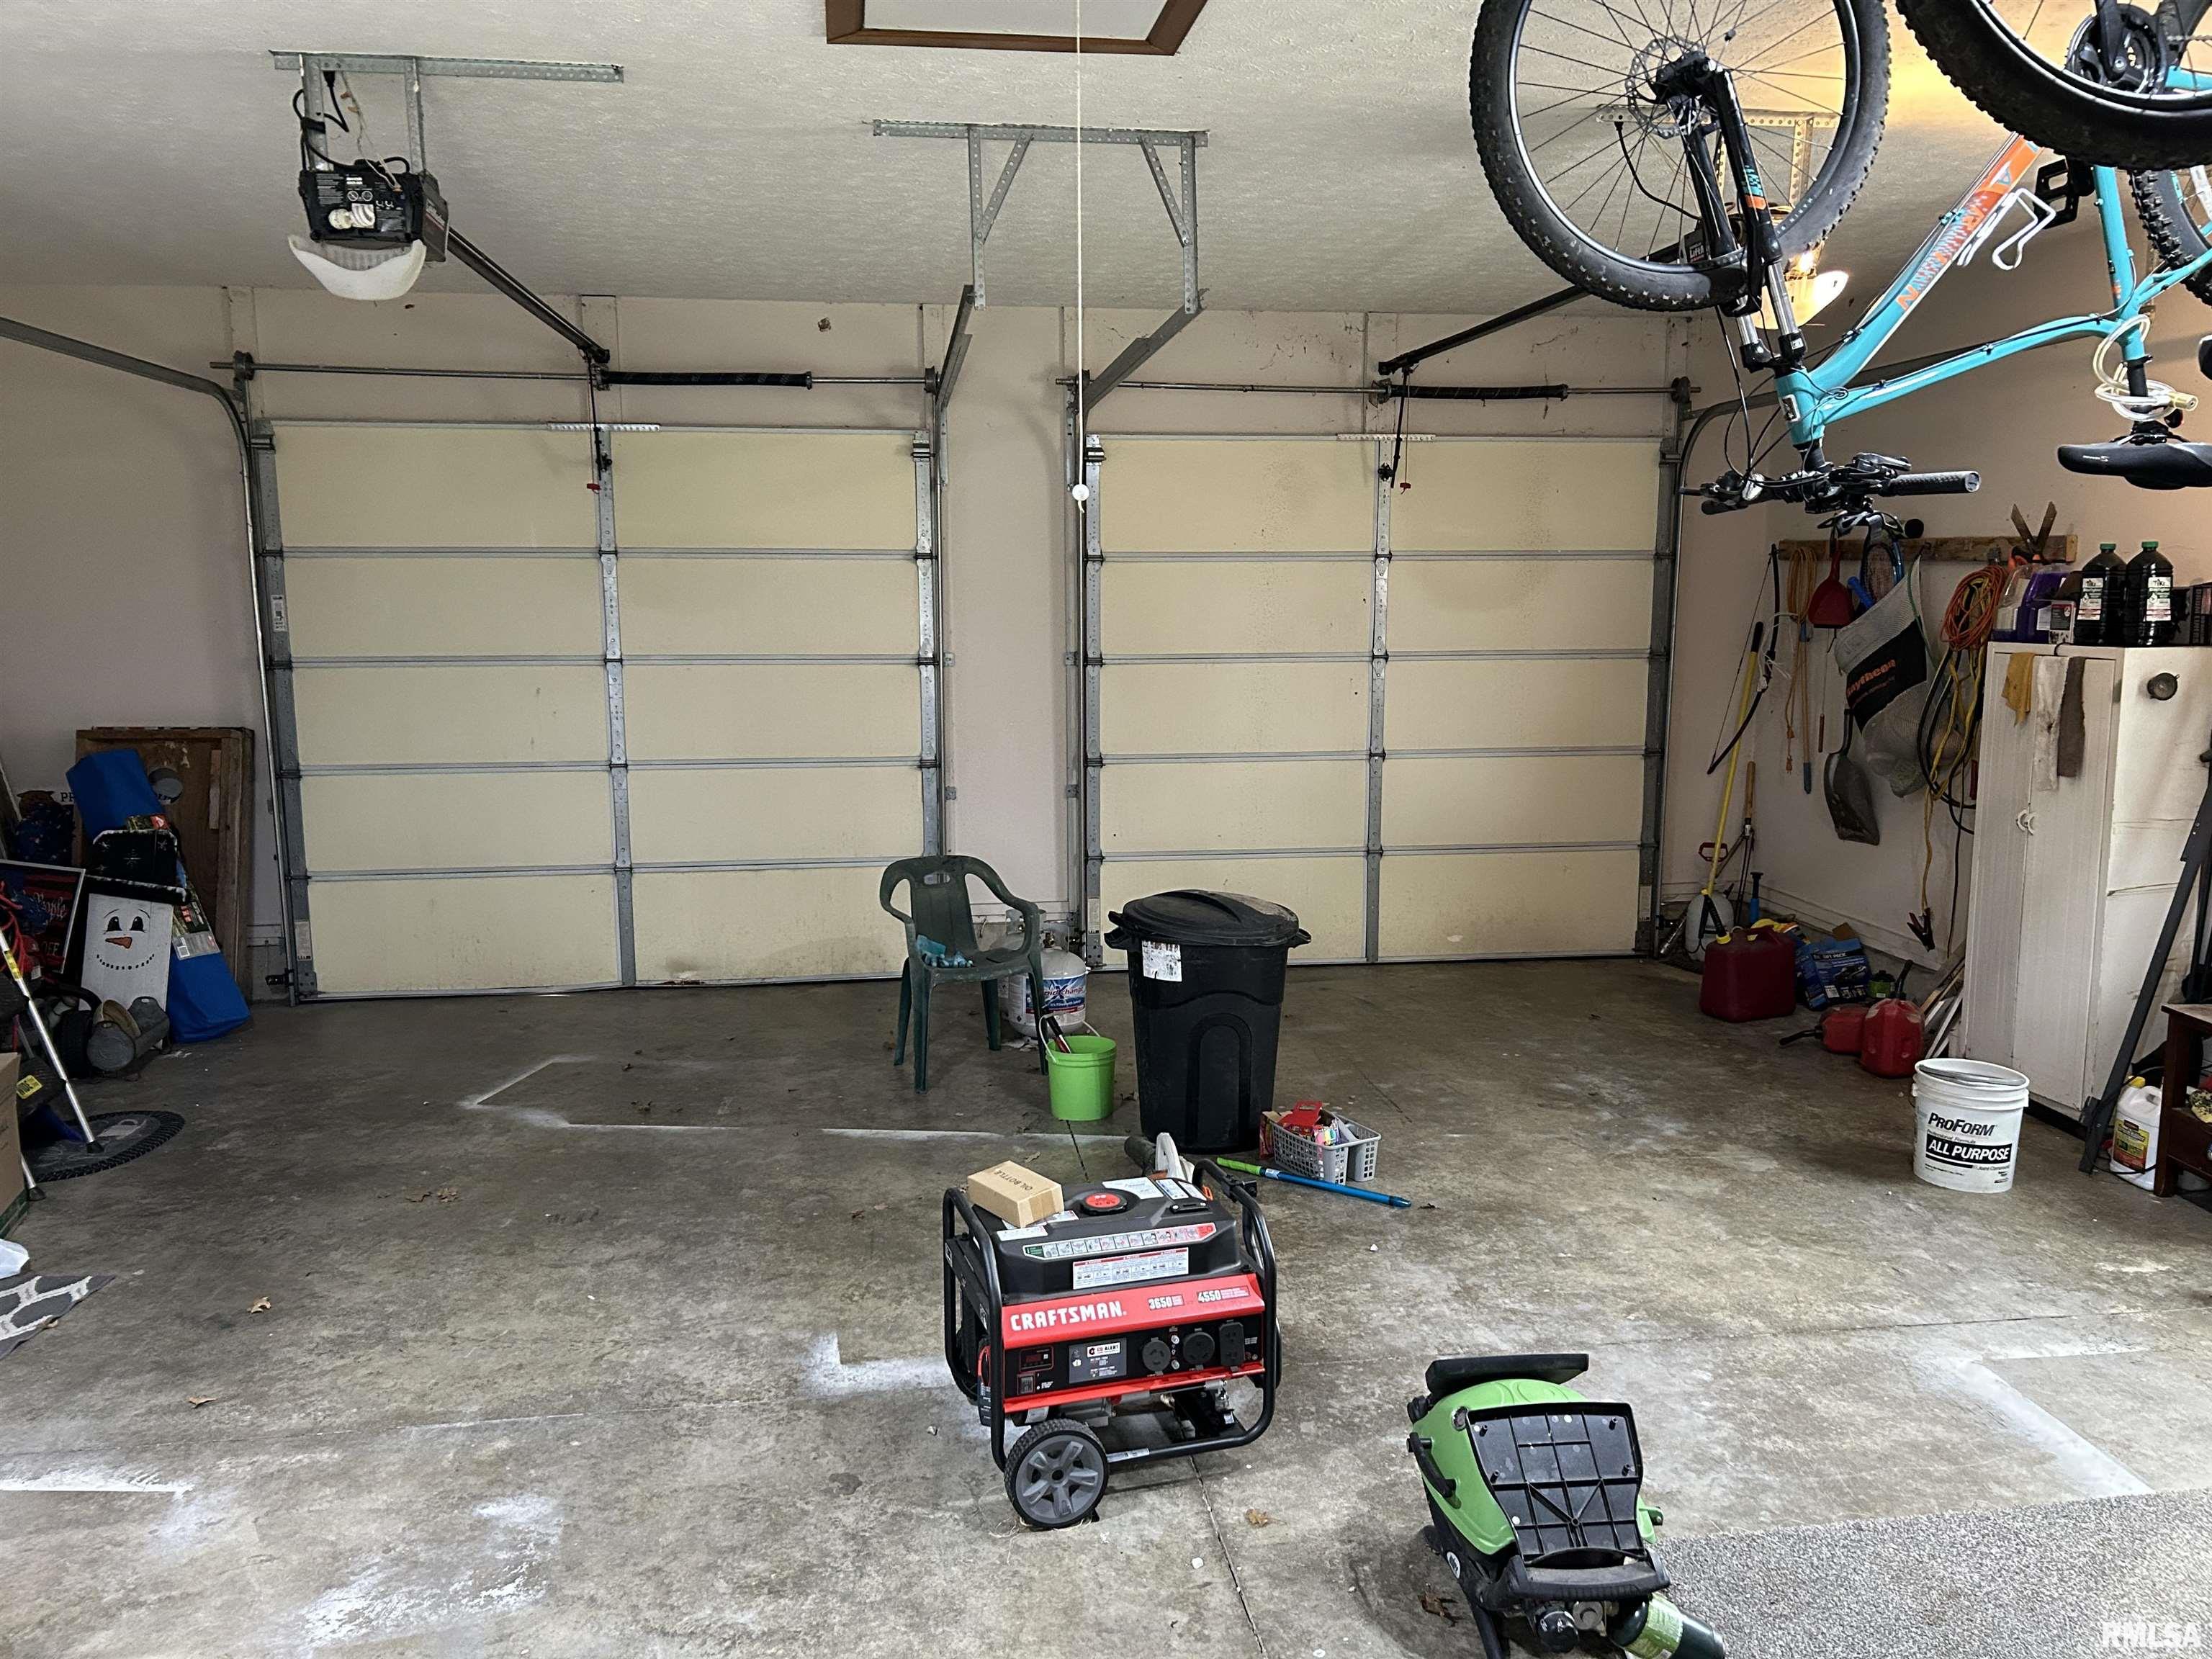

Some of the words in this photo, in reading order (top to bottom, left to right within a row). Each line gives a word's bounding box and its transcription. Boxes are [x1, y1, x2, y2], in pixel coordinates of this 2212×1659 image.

[1897, 141, 2038, 311] ARIN
[1928, 1139, 1950, 1155] ALL
[1951, 1145, 2010, 1161] PURPOSE
[994, 1169, 1022, 1185] BOTTLE
[1148, 1296, 1173, 1310] 3650
[1197, 1290, 1222, 1303] 4550
[1010, 1300, 1124, 1332] CRAFTSMAN
